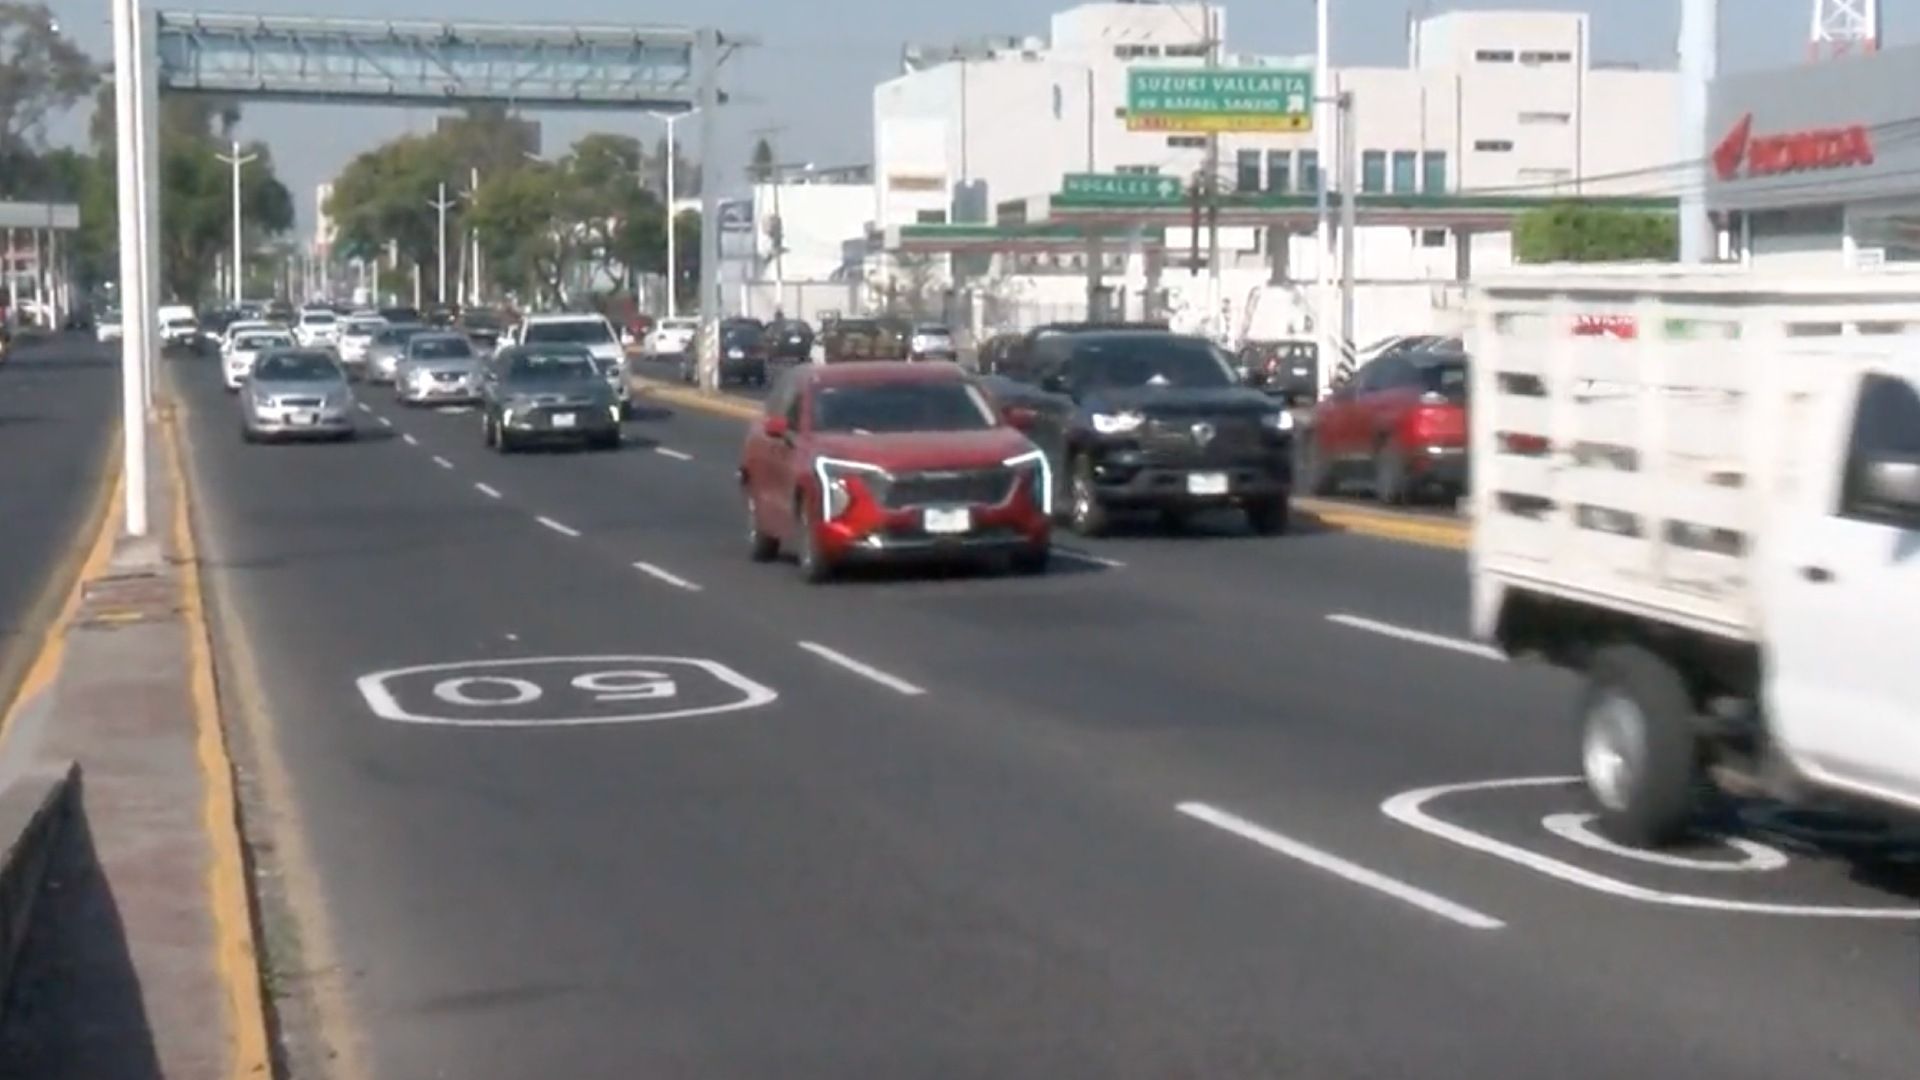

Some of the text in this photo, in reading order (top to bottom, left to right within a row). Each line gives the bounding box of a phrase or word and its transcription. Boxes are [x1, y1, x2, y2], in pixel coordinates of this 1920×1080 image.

[1137, 76, 1305, 93] SUZUKI VALLARTA
[1069, 180, 1150, 195] NOGALES
[432, 669, 677, 706] 50
